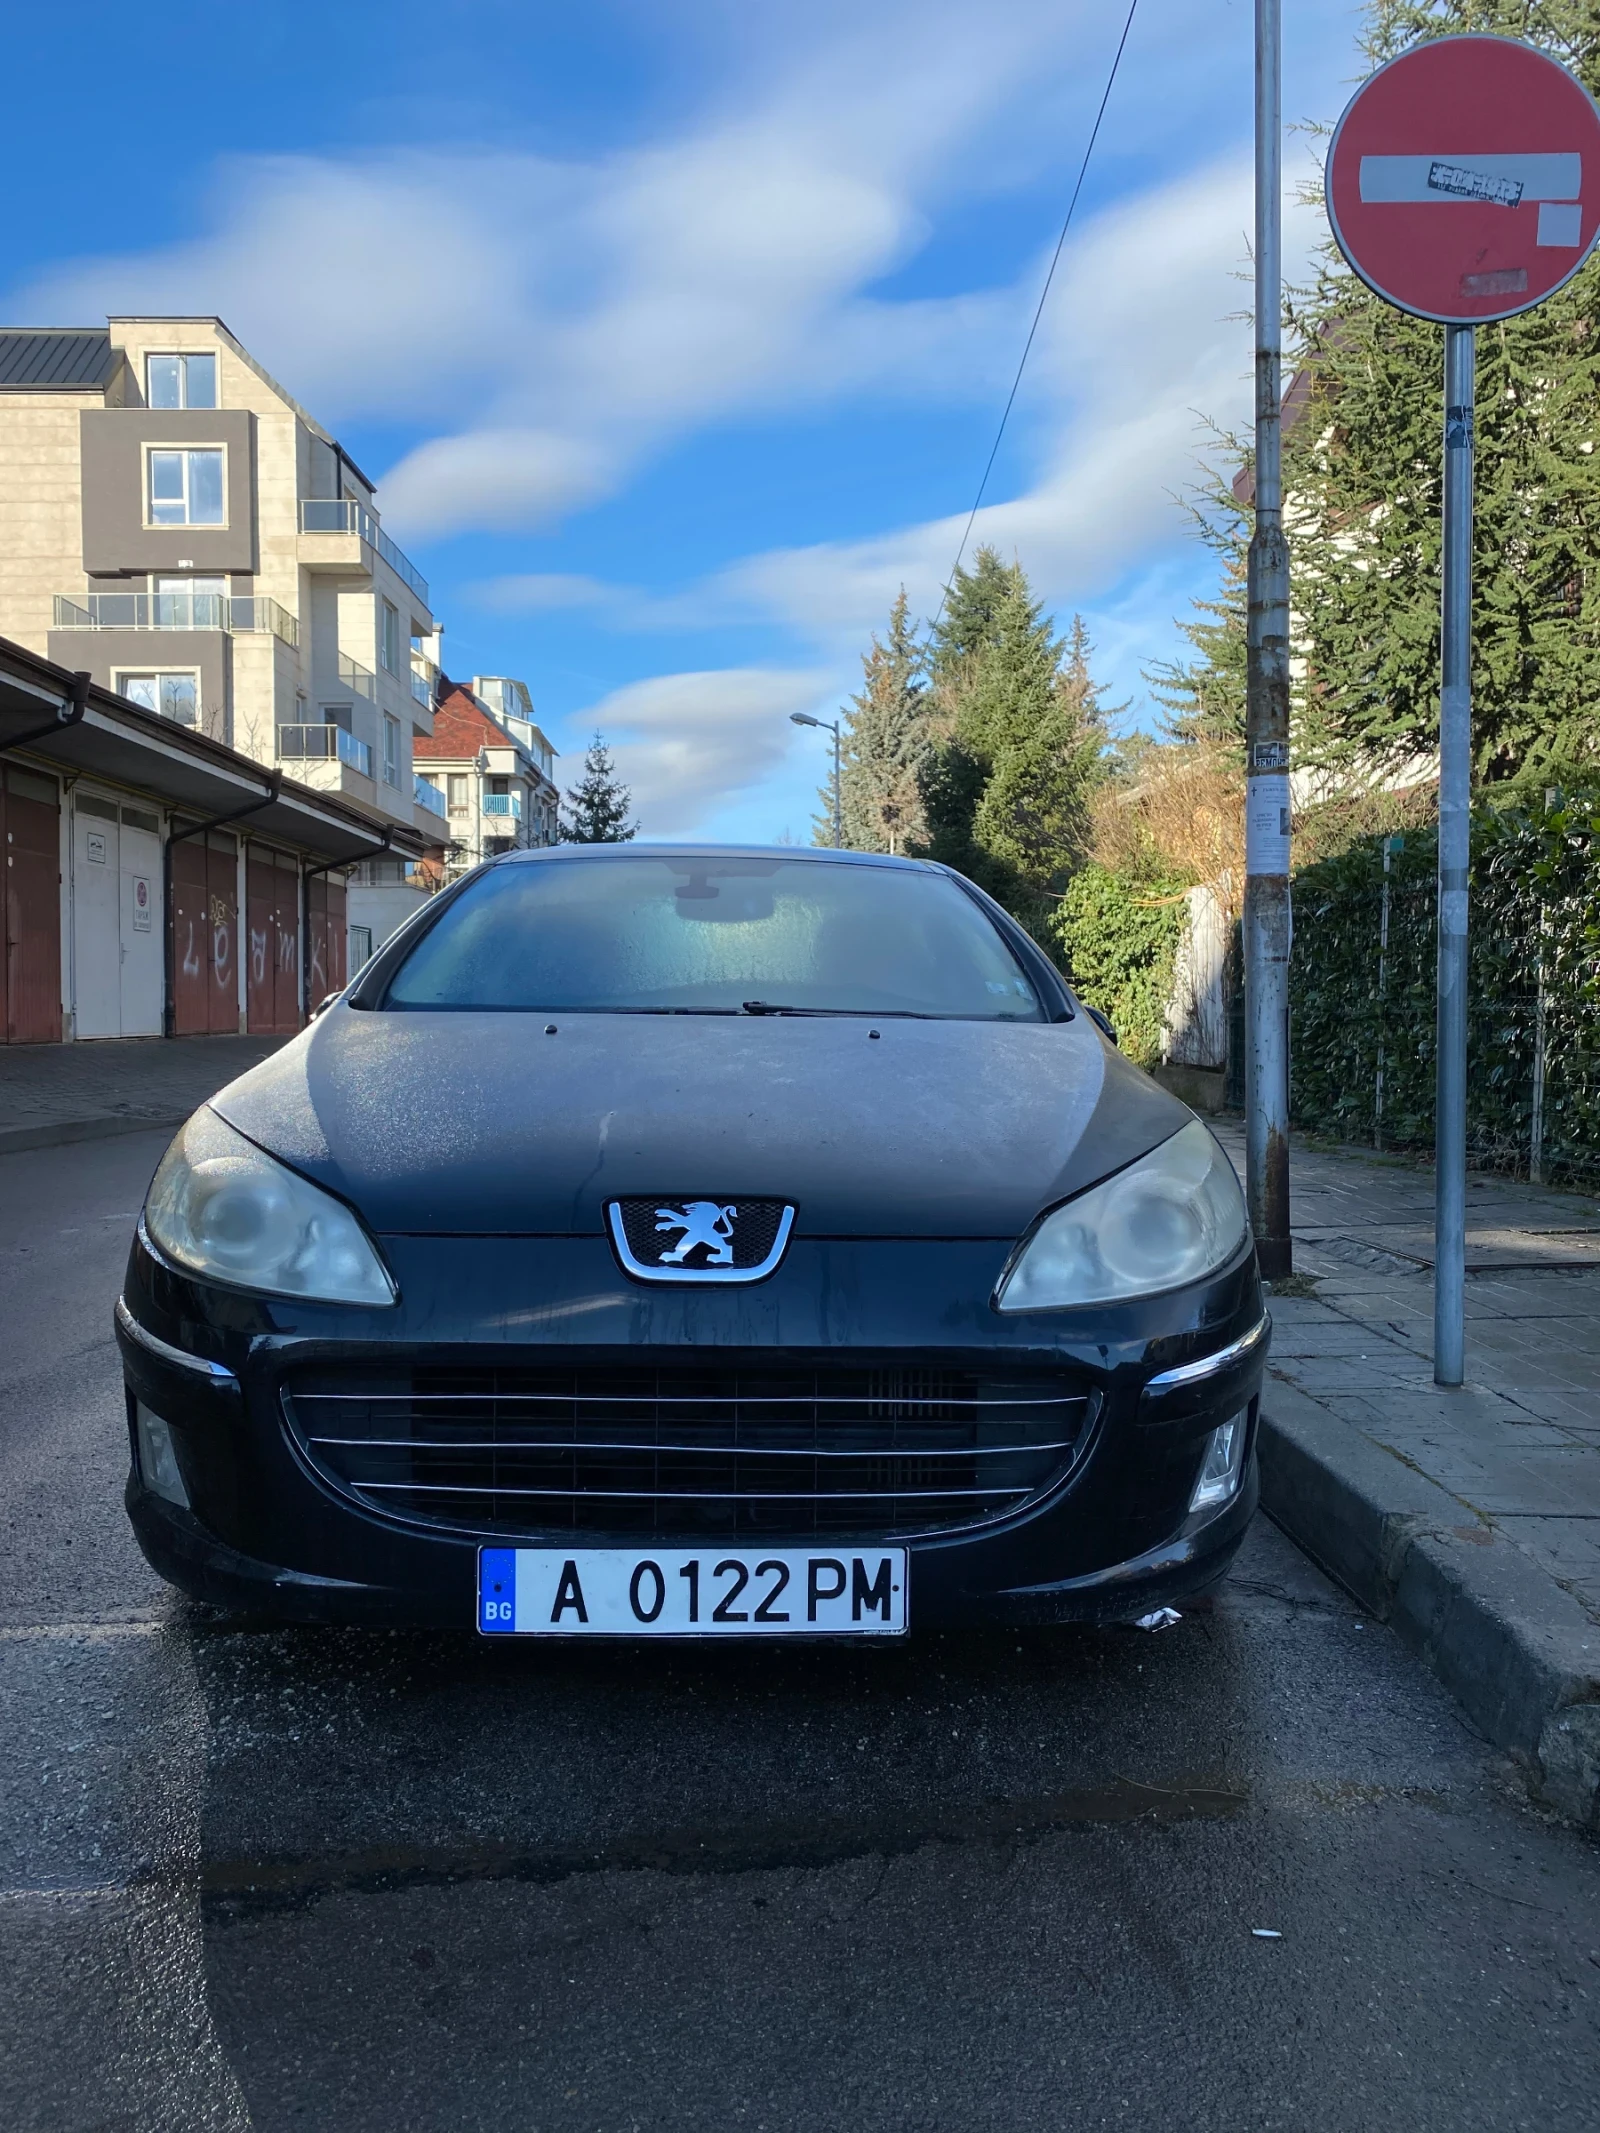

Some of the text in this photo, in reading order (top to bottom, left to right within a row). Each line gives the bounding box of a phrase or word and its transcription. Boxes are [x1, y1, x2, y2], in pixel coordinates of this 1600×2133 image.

[485, 1601, 512, 1620] BG
[550, 1558, 892, 1623] A 0122 PM
